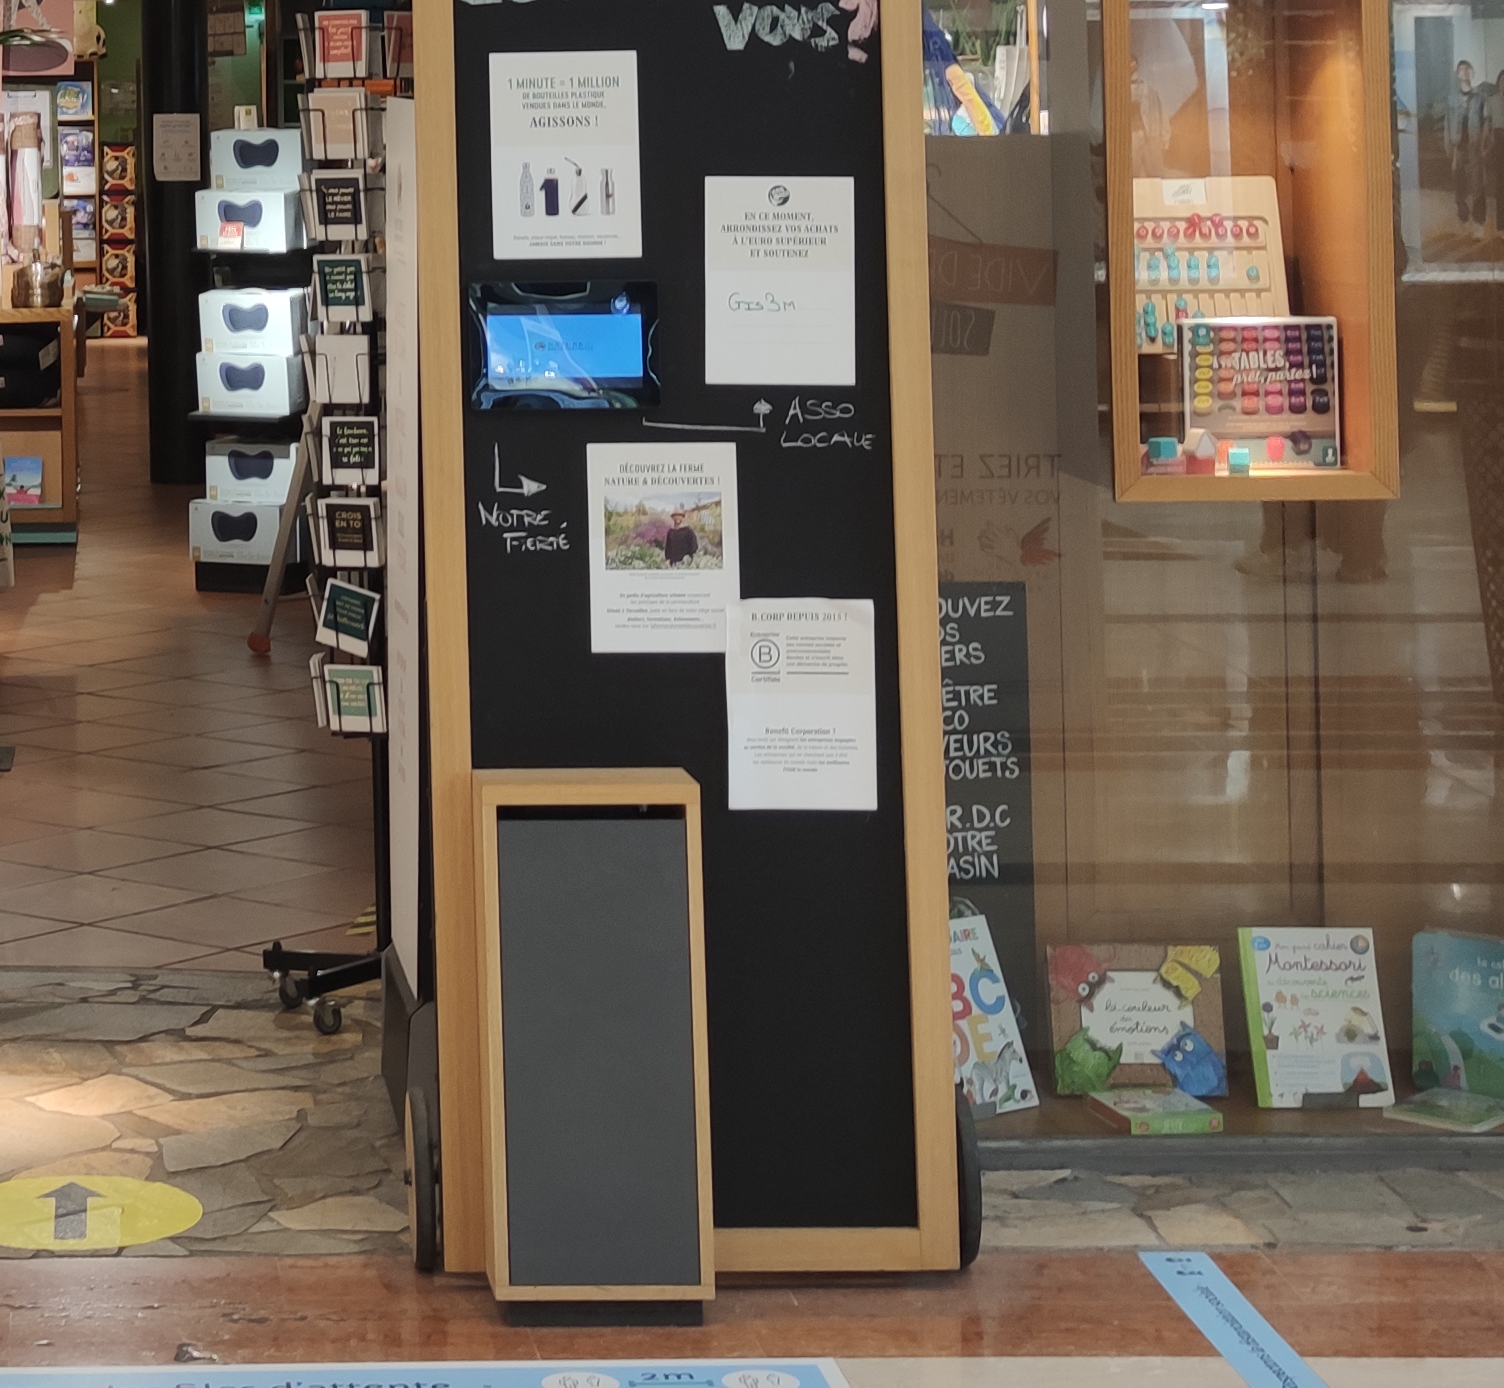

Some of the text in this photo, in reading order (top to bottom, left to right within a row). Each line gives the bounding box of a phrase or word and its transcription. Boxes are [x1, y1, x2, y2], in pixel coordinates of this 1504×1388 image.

[507, 75, 620, 90] 1 MINUTE 1 MILLION
[522, 91, 605, 100] DE BOUTEILLES PLASTIQUE
[522, 101, 579, 110] VENDUES DANS LE
[530, 115, 591, 128] AGISSONS
[744, 212, 756, 221] EN
[758, 212, 770, 221] CE
[720, 224, 839, 234] ARRONDISSEZ VOS ACHATS
[750, 248, 809, 258] ET SOUTENEZ
[785, 397, 855, 425] ASSO
[780, 430, 877, 451] LOCALE
[618, 462, 704, 474] DÉCOUVREZ LA FERME
[604, 476, 640, 487] NATURE
[642, 476, 648, 486] &
[650, 474, 715, 487] DÉCOUVERTES
[478, 502, 551, 529] NOTRE
[760, 612, 785, 622] CORP
[786, 612, 820, 622] DEPUIS
[822, 612, 843, 622] 2015
[1266, 952, 1367, 974] Montessori
[1108, 1020, 1170, 1036] émotions
